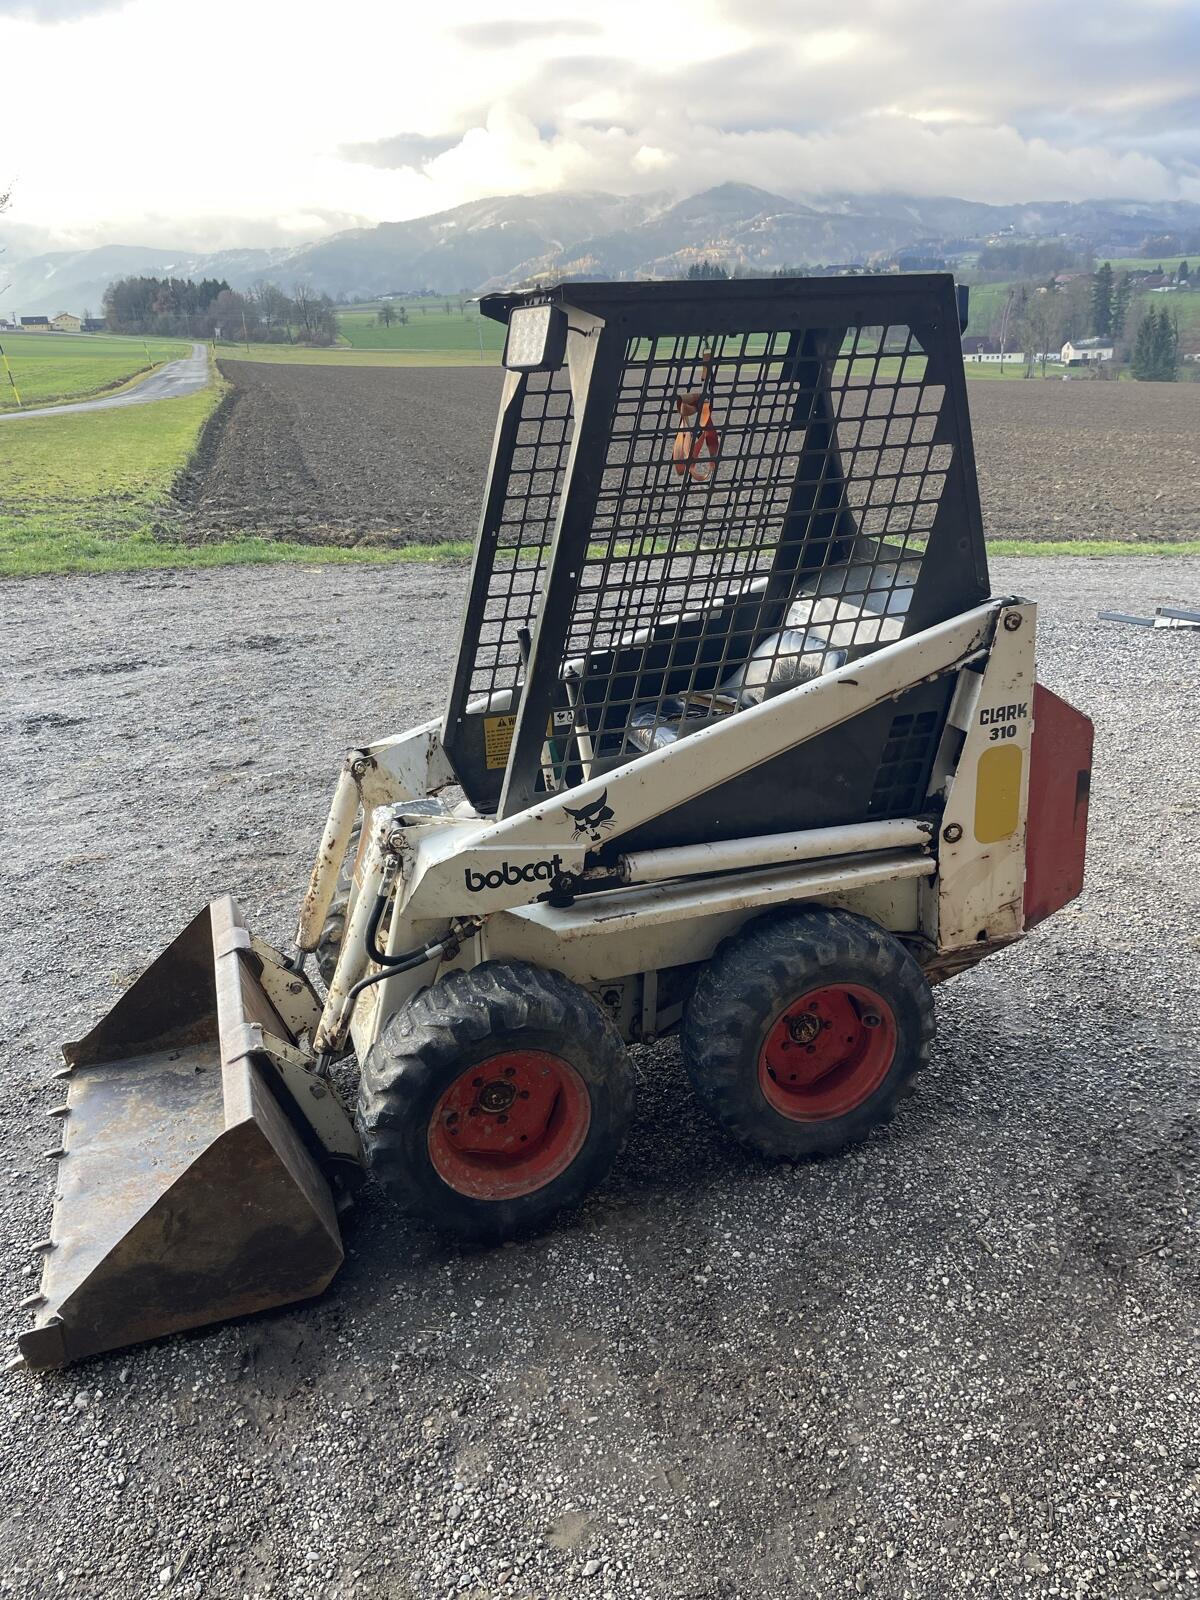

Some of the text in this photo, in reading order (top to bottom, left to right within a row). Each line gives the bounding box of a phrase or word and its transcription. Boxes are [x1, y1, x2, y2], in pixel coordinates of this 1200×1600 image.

[979, 703, 1028, 725] CLARK
[989, 724, 1017, 741] 310
[464, 854, 563, 892] bobcat
